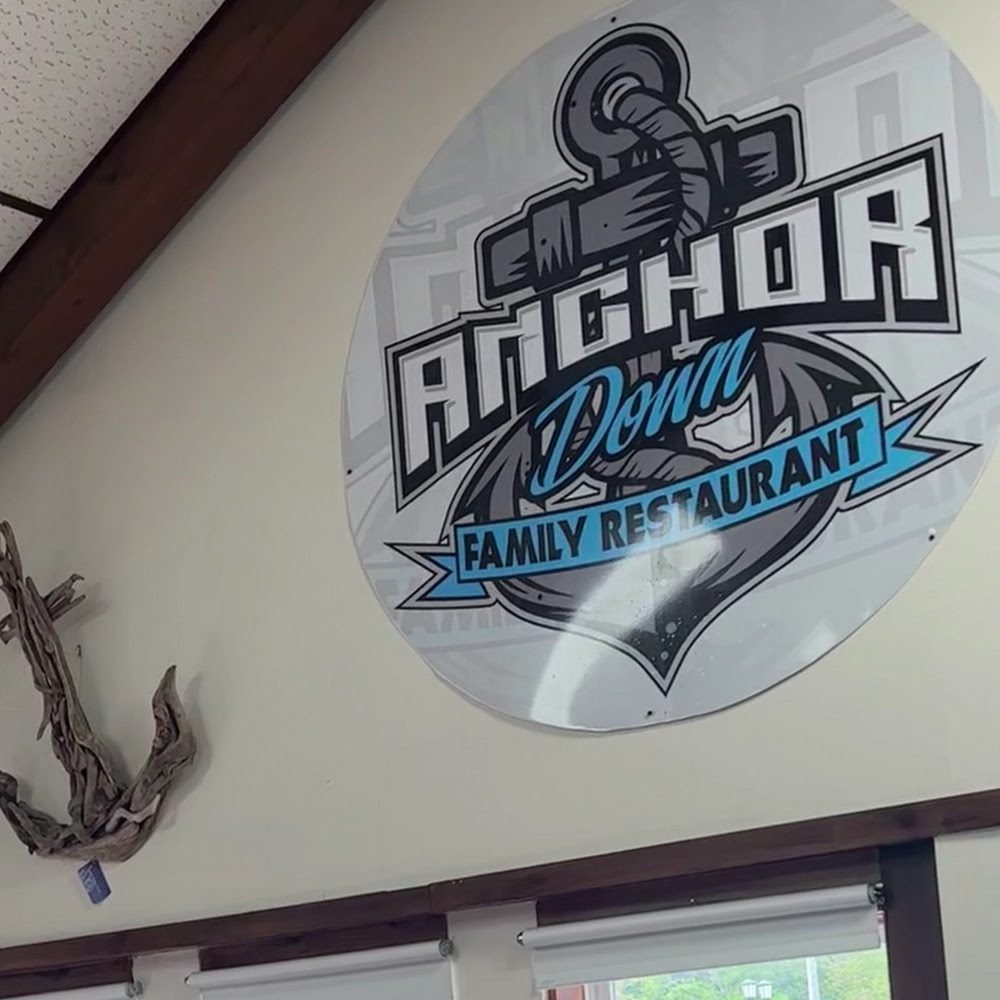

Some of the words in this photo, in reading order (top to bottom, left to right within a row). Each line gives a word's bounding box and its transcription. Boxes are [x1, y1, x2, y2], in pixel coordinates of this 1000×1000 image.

[397, 156, 938, 477] ANCHOR
[462, 514, 588, 572] FAMILY
[599, 417, 865, 552] RESTAURANT
[529, 326, 757, 496] Down
